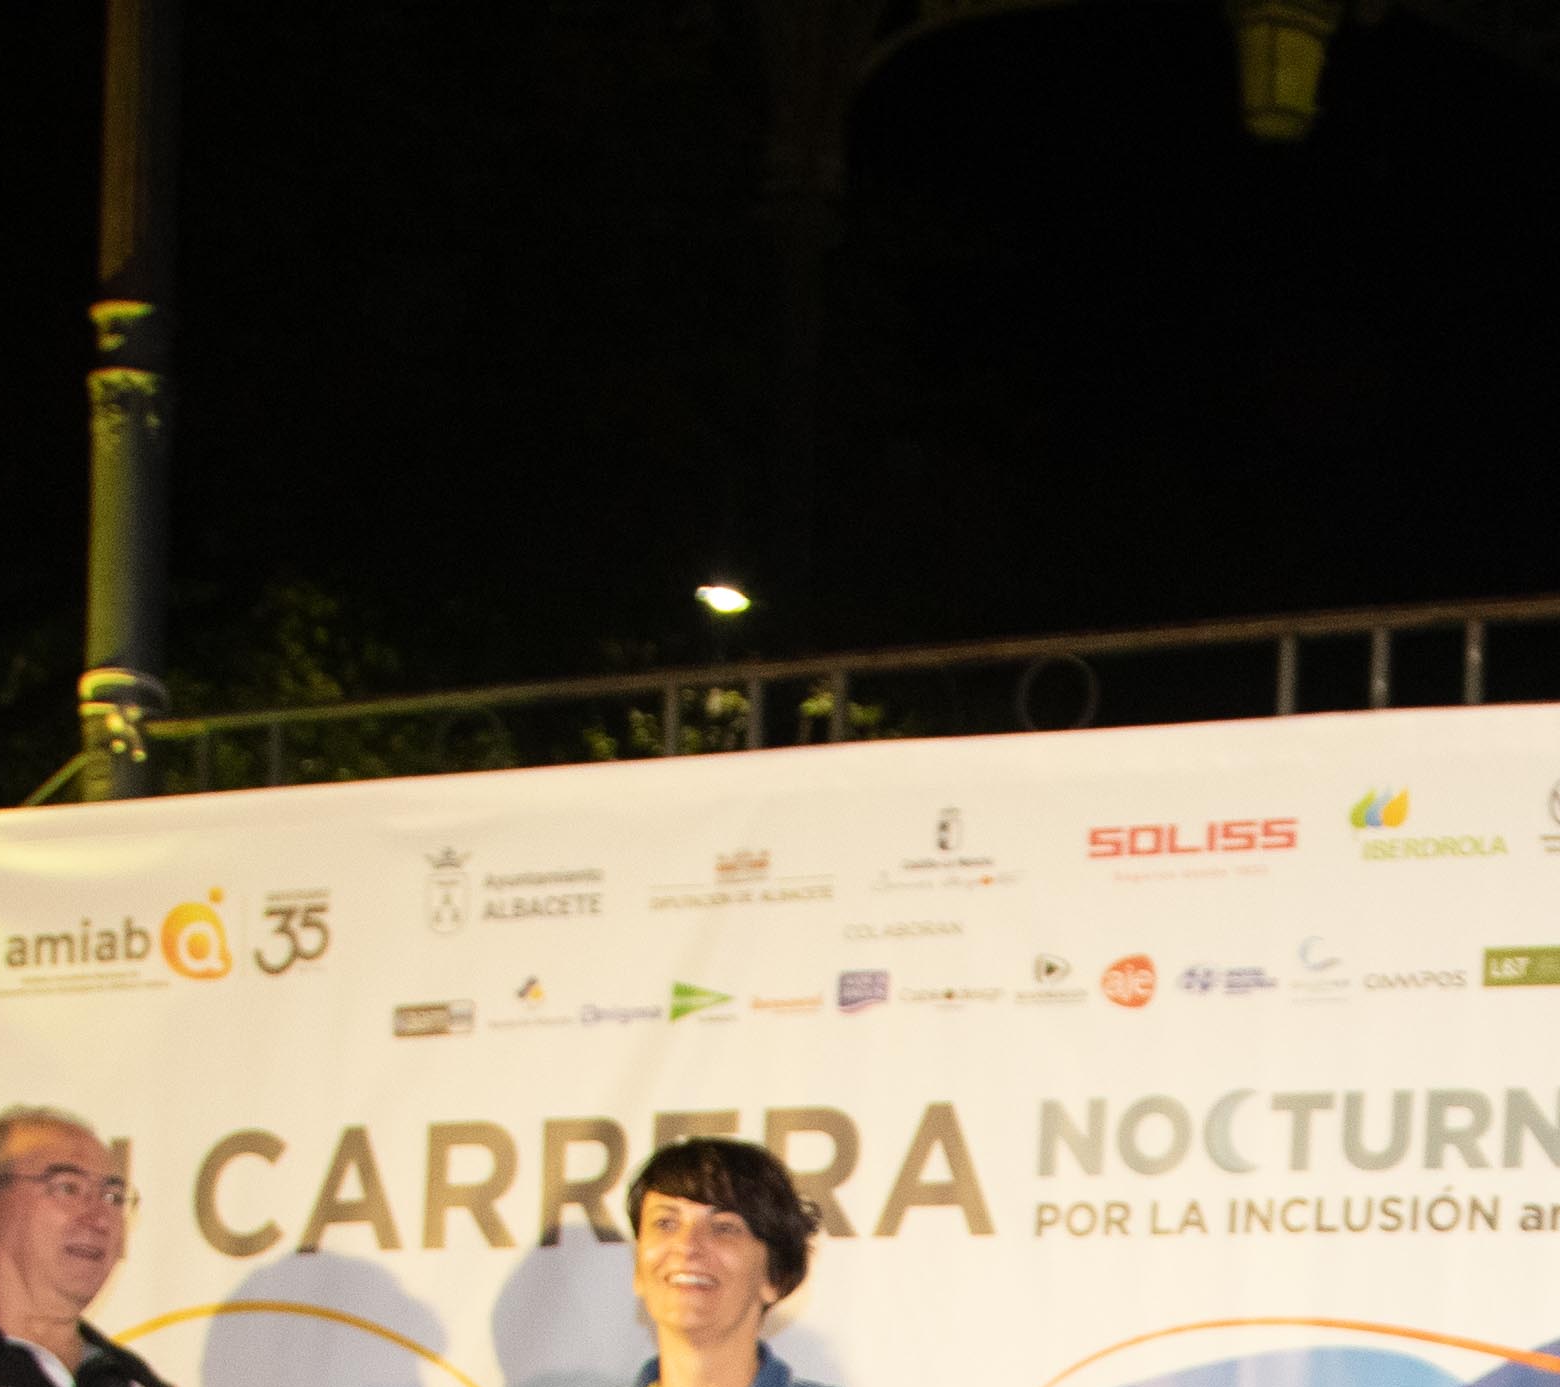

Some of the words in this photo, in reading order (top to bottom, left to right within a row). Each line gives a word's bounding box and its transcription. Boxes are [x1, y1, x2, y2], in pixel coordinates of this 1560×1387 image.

[1087, 817, 1300, 859] SOLISS
[1362, 834, 1509, 860] IBERDROLA
[483, 892, 603, 919] ALBACETE
[5, 915, 152, 968] amiab
[253, 901, 329, 975] 35
[1035, 1201, 1130, 1237] POR
[1149, 1199, 1208, 1236] LA
[1227, 1185, 1499, 1234] INCLUSIÓN
